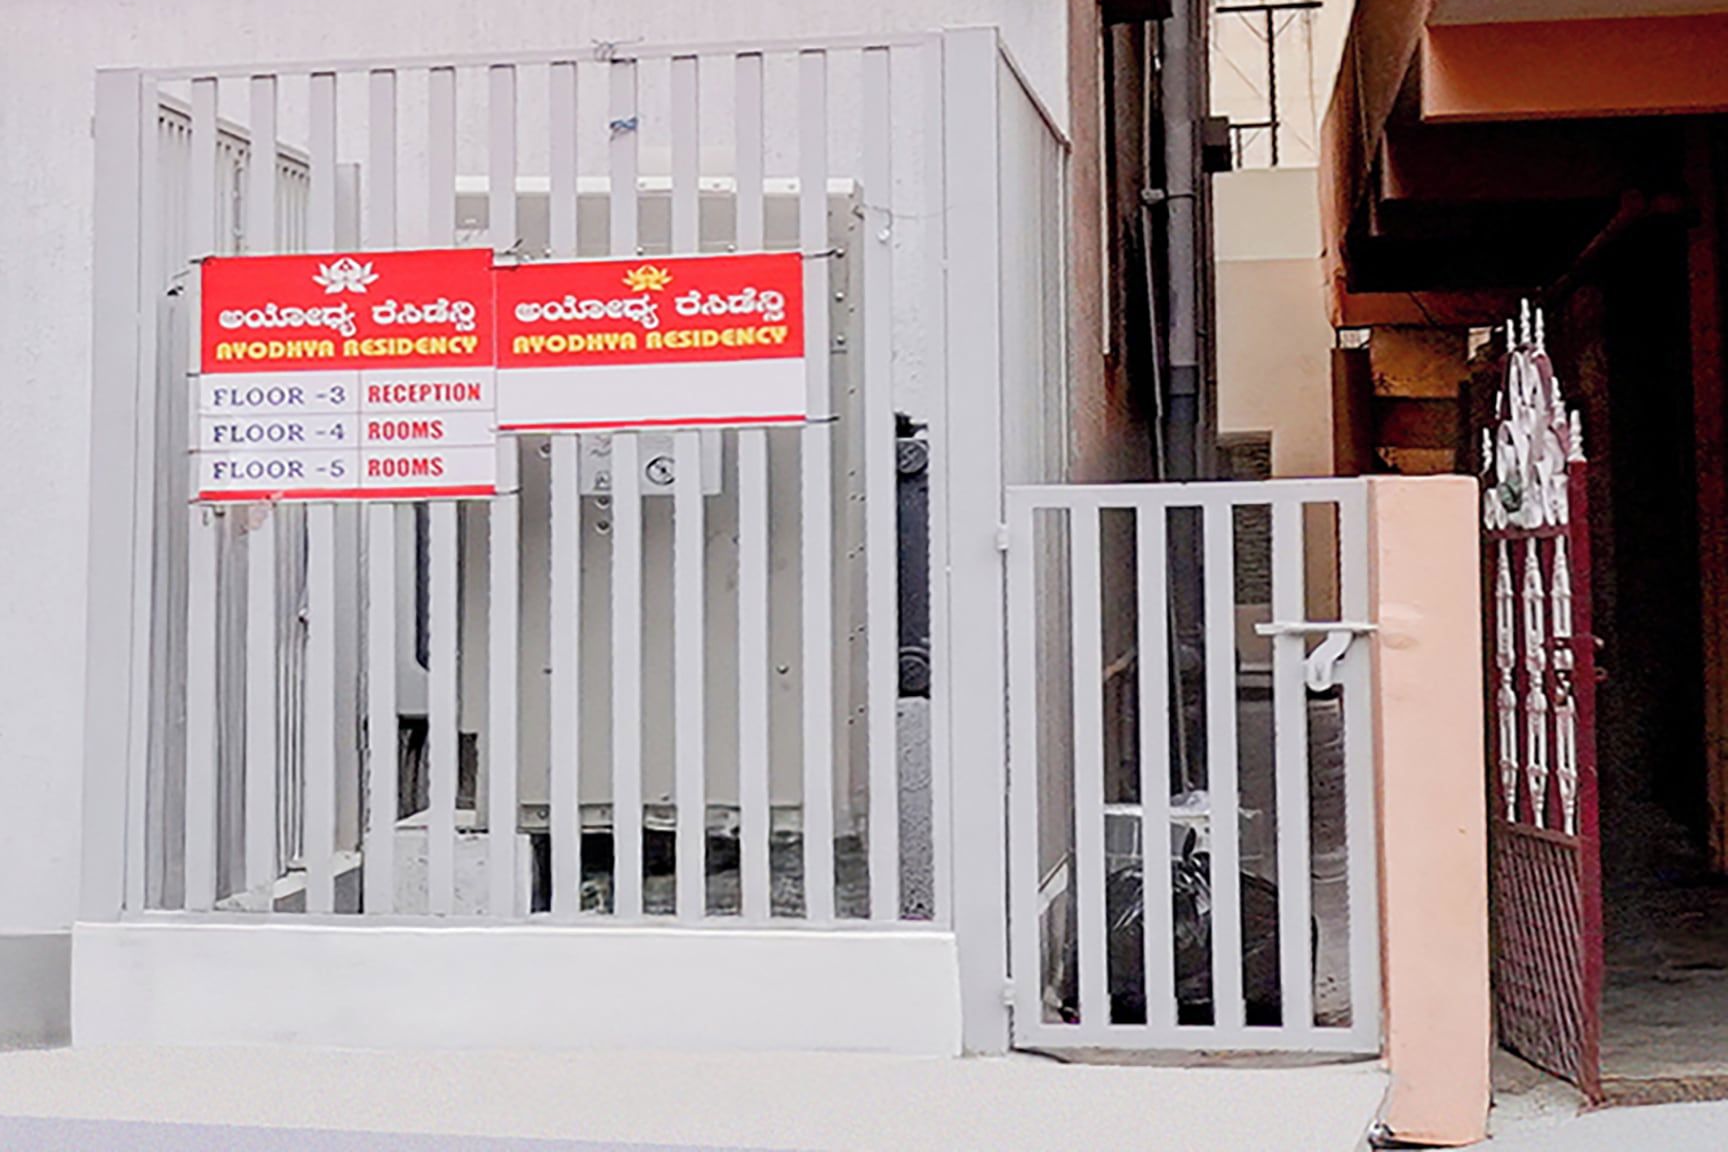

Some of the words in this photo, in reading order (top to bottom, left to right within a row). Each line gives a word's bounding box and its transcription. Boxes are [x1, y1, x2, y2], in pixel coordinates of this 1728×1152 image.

[218, 301, 357, 337] ಅಯೋಧ್ಯ
[514, 292, 660, 330] ಅಯೋಧ್ಯ
[215, 339, 336, 361] AYODHYA
[342, 335, 479, 358] RESIDENCY
[512, 331, 638, 354] AYODHYA
[645, 325, 789, 350] RESIDENCY
[212, 385, 305, 407] FLOOR
[367, 382, 482, 404] RECEPTION
[212, 423, 305, 444] FLOOR
[367, 419, 445, 441] ROOMS
[212, 459, 305, 480] FLOOR
[367, 456, 445, 478] ROOMS
